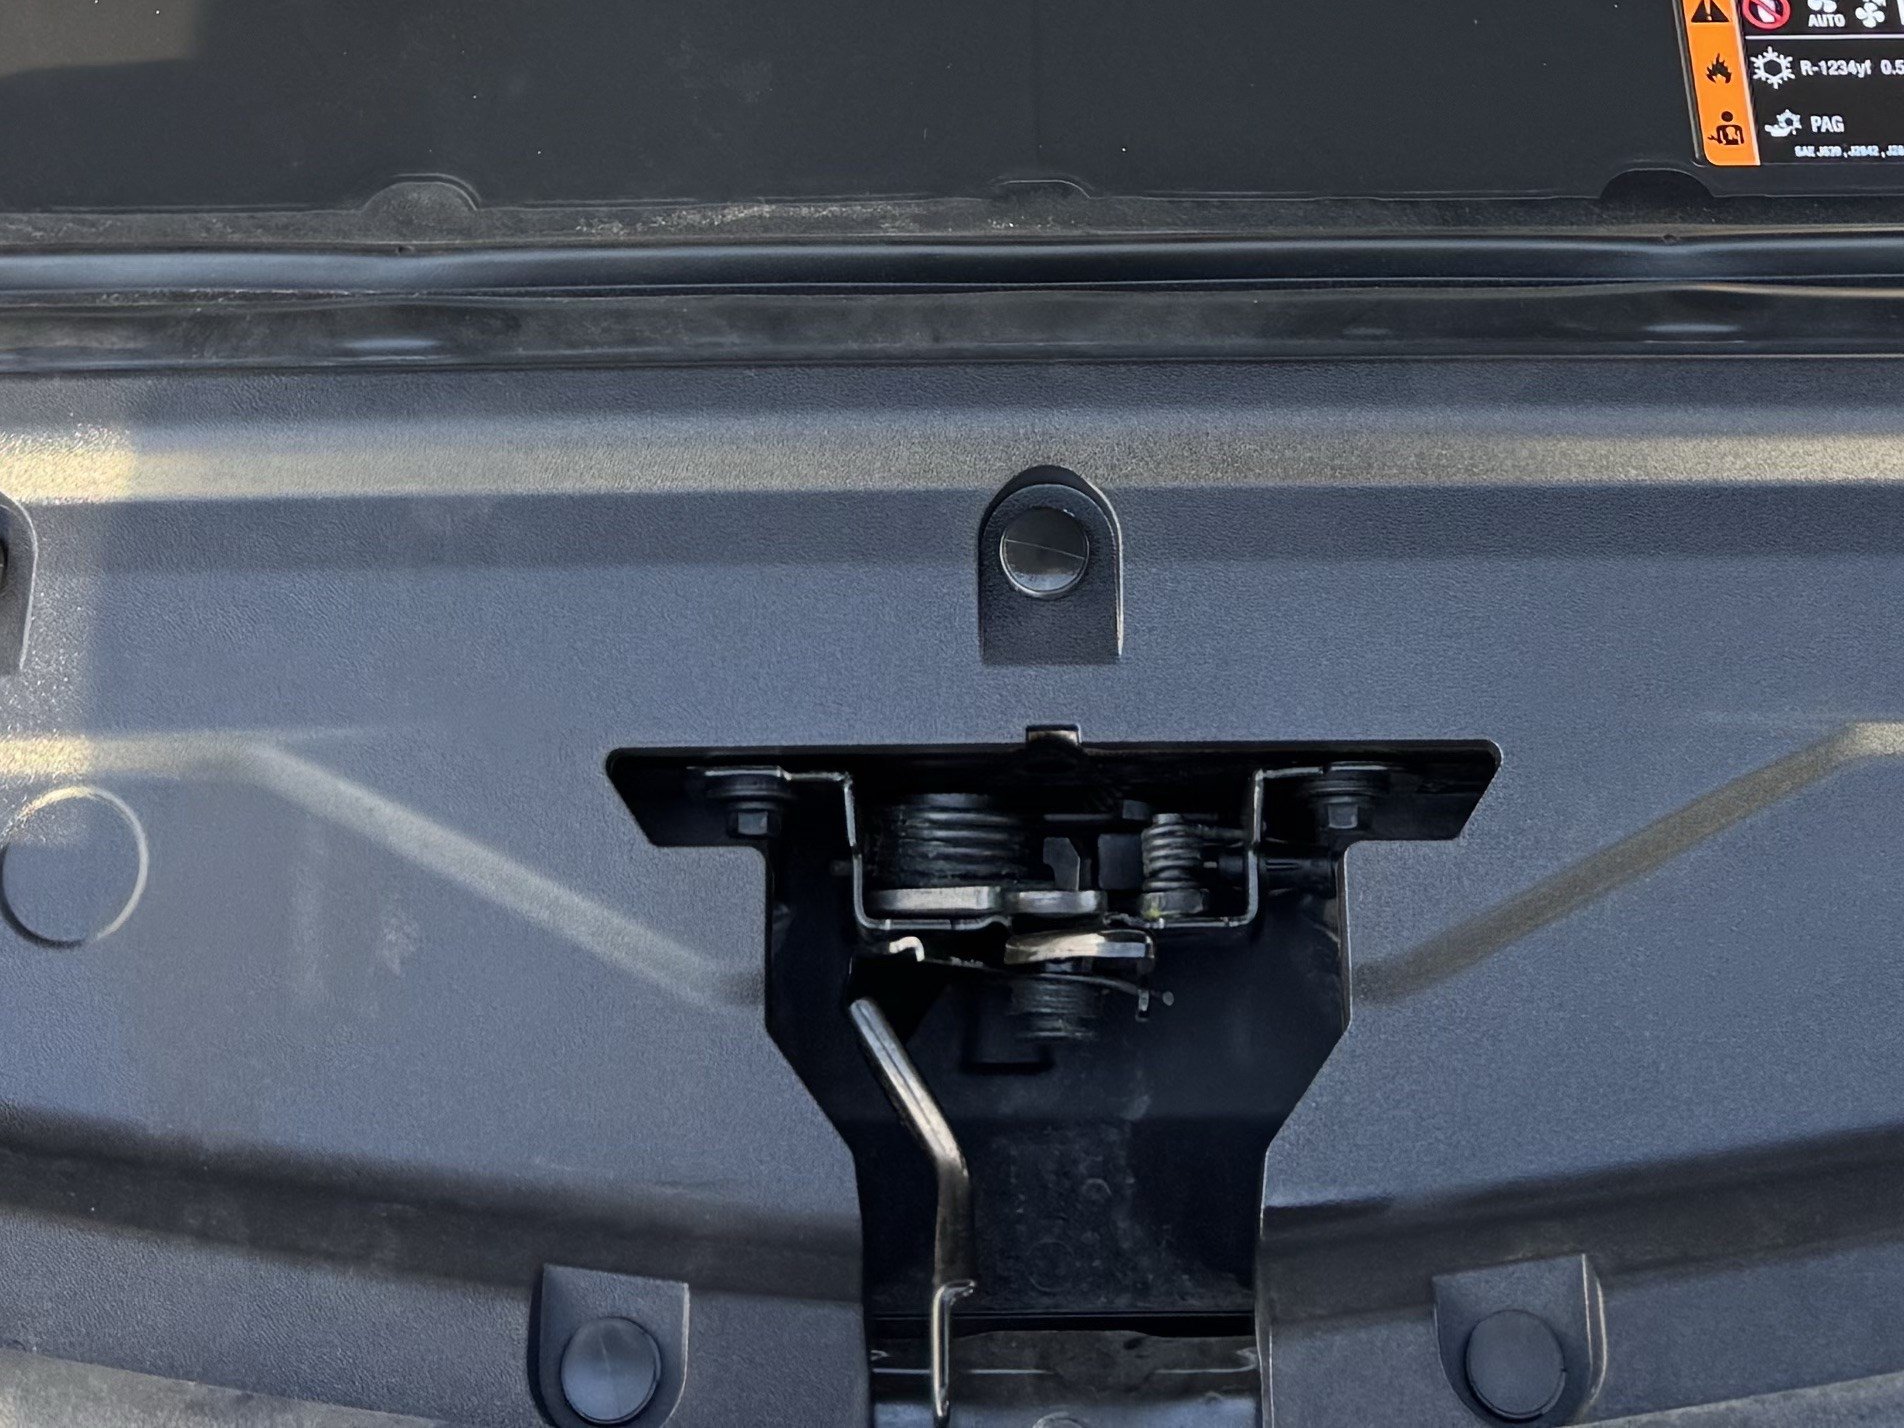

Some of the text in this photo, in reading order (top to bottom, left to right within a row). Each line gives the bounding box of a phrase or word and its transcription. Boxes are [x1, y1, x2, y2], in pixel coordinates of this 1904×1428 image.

[1808, 14, 1845, 27] AUTO
[1800, 59, 1871, 77] R-1234yf
[1811, 116, 1844, 132] PAG
